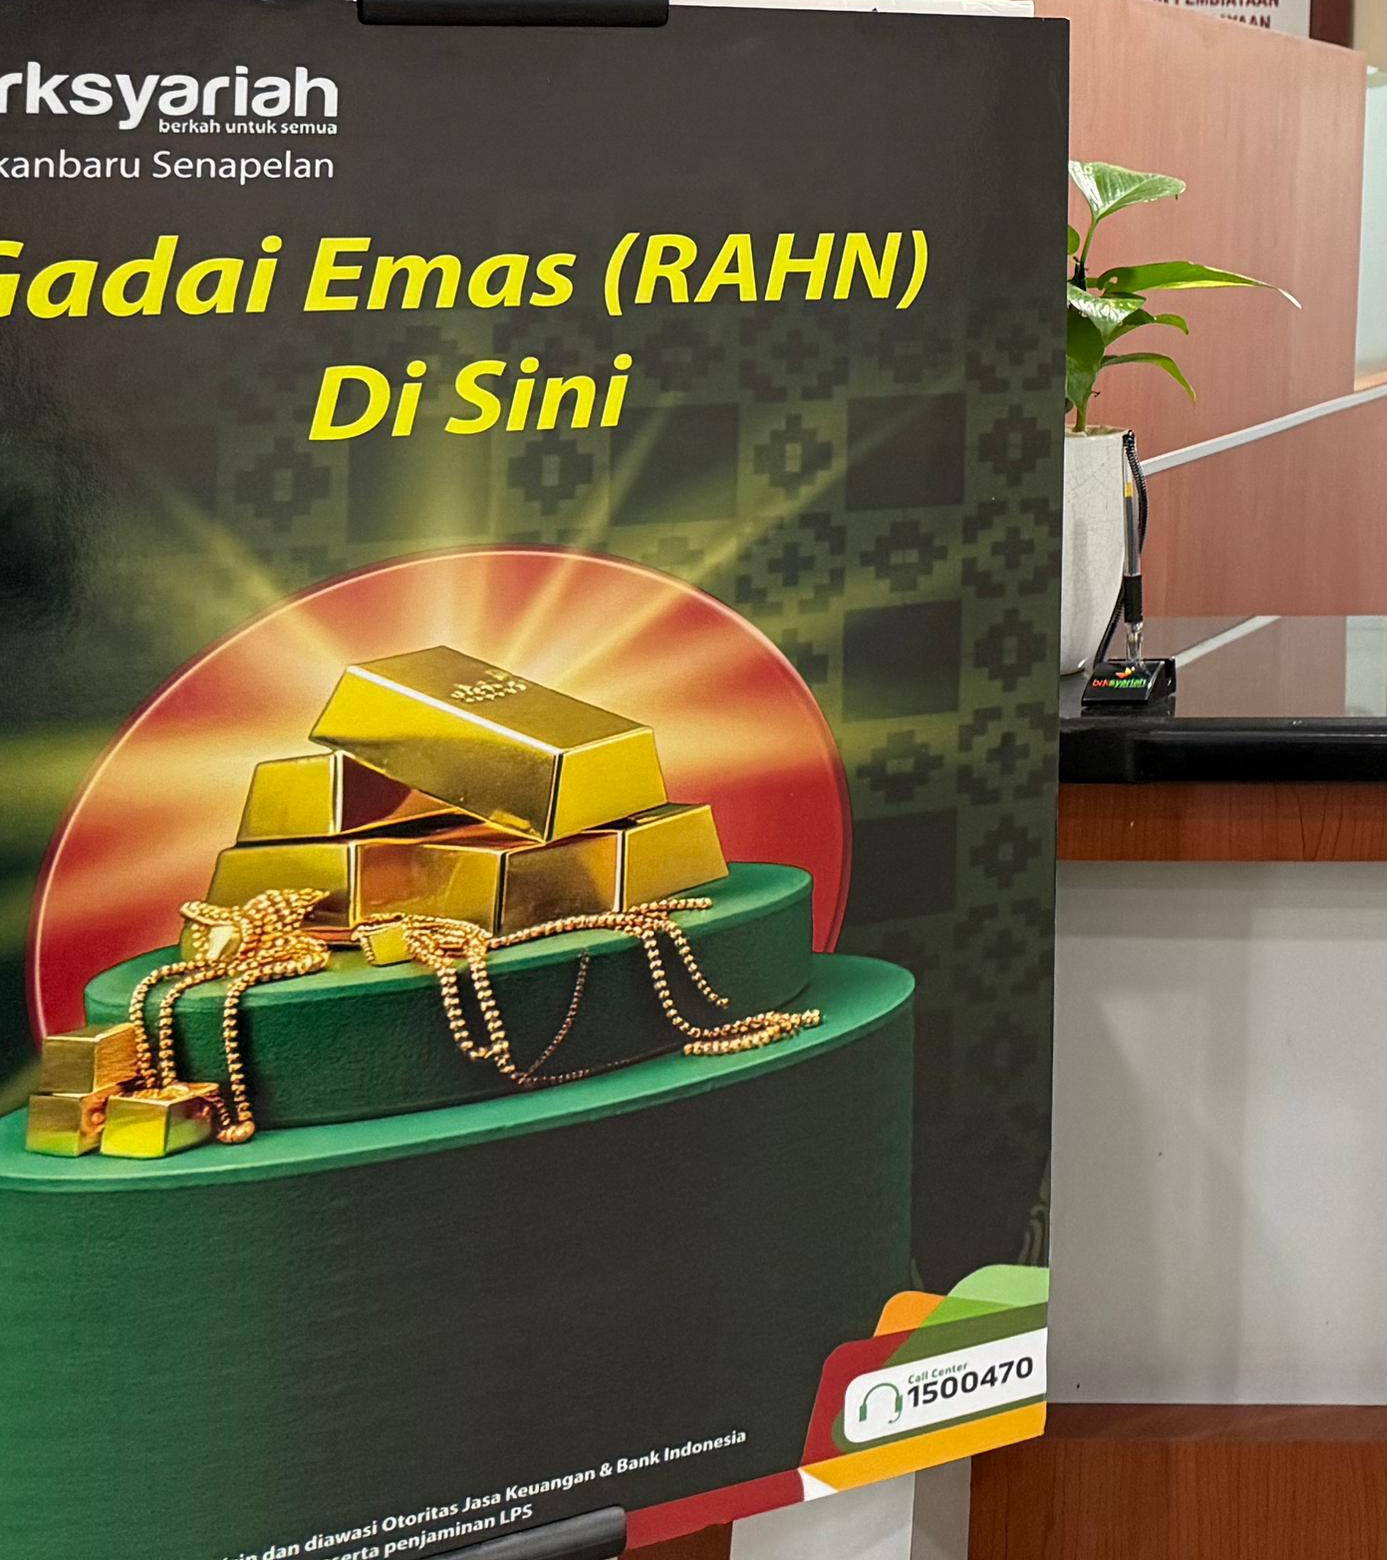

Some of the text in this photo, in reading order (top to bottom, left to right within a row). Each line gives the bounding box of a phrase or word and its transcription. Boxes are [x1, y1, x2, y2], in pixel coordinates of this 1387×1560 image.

[0, 61, 338, 130] rksyariah
[159, 118, 338, 135] berkah untuk semua
[152, 150, 335, 185] Senapelan
[302, 236, 577, 313] Emas
[604, 229, 929, 316] (RAHN)
[308, 353, 633, 441] Di Sini
[907, 1362, 968, 1384] Call Center
[907, 1356, 1033, 1408] 1500470
[263, 1430, 747, 1560] dan diawasi Otoritas Jasa Keuangan & Bank Indonesia
[323, 1503, 533, 1560] erta penjaminan LPS
